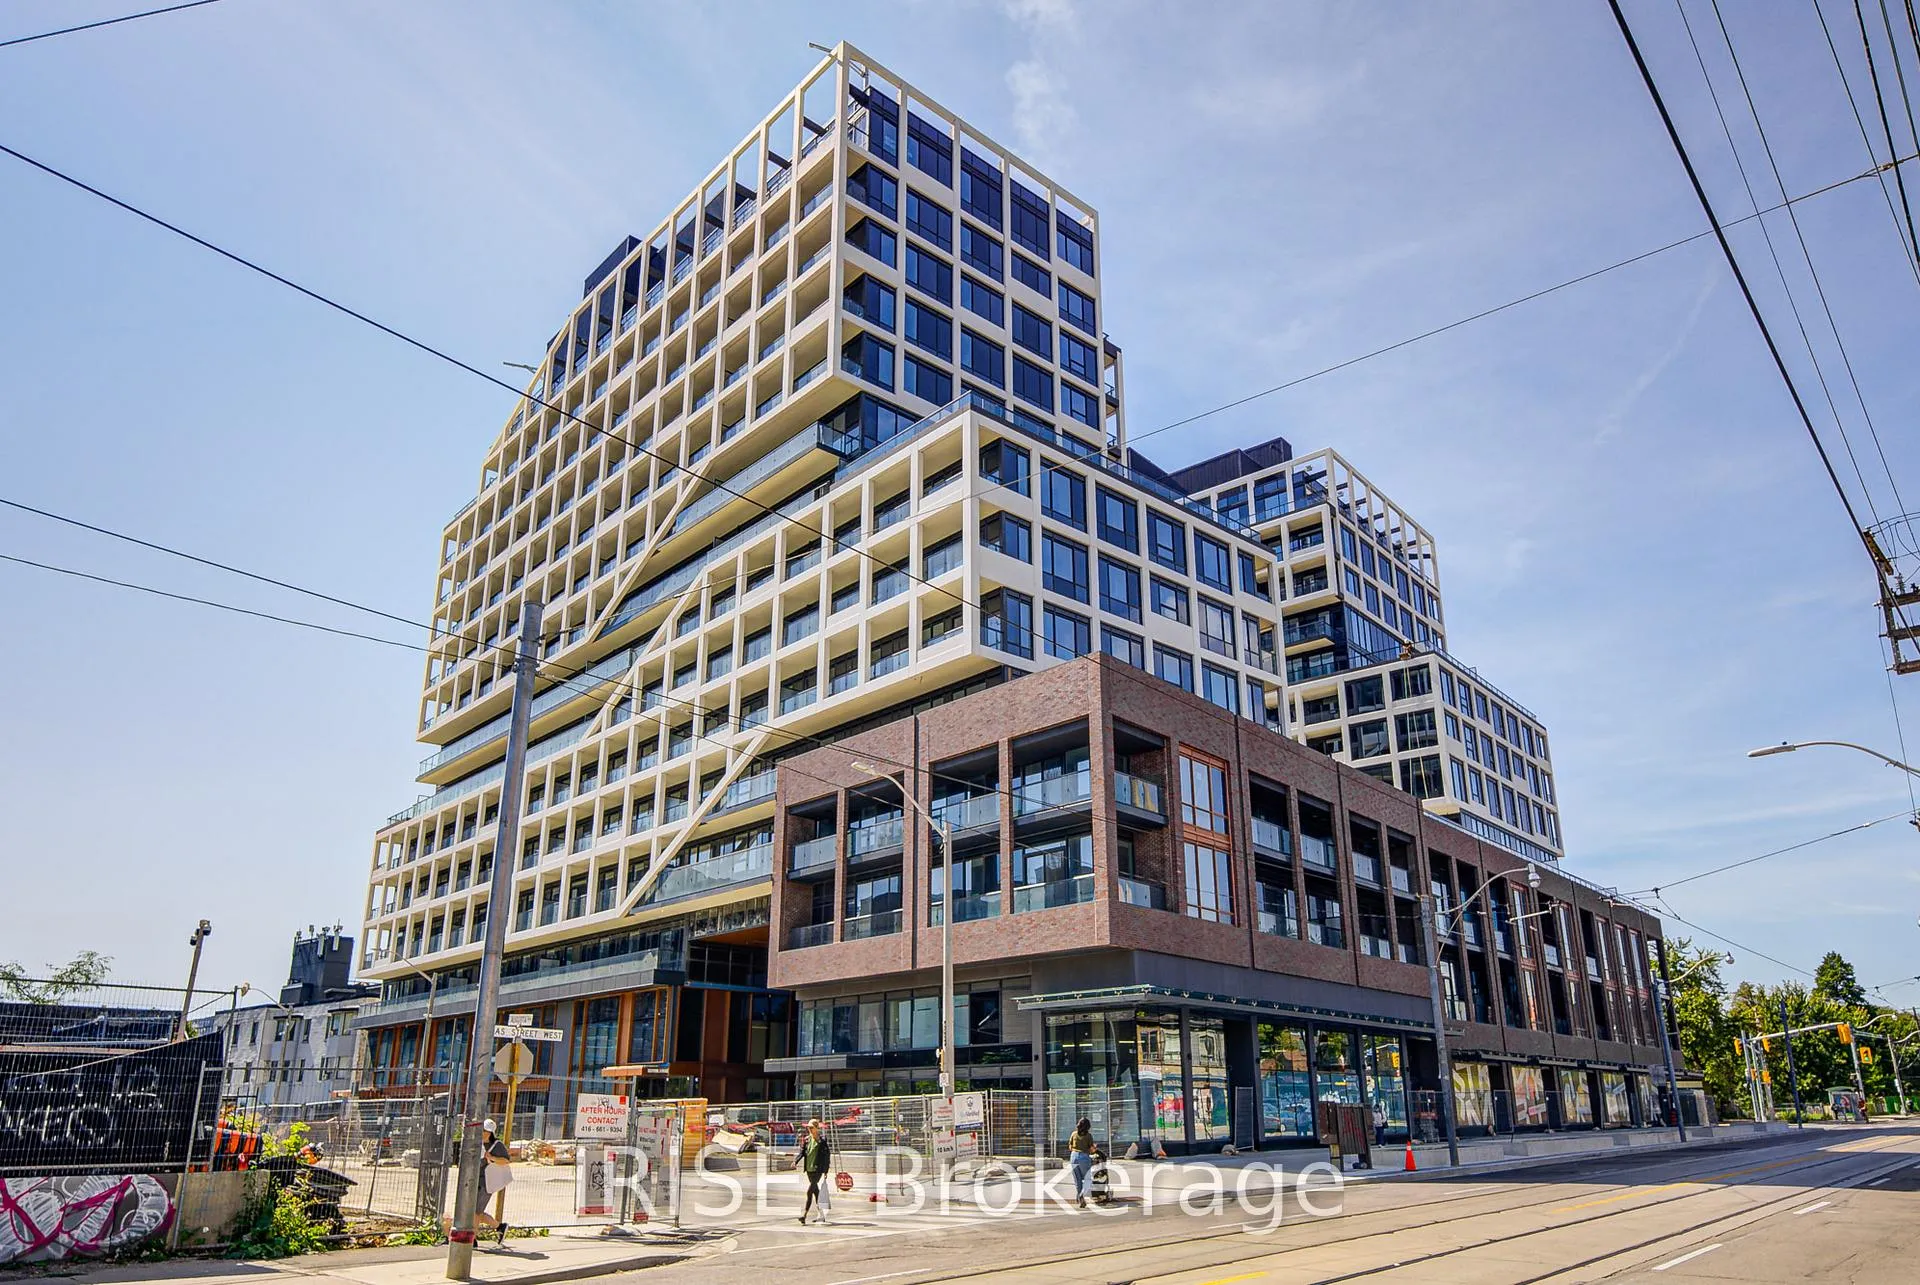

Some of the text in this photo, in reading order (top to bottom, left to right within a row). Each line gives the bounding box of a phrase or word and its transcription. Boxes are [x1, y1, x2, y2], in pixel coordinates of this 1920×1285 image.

[512, 1030, 538, 1038] STREET
[581, 1106, 626, 1115] AFTER HOURS
[587, 1116, 618, 1125] CONTACT
